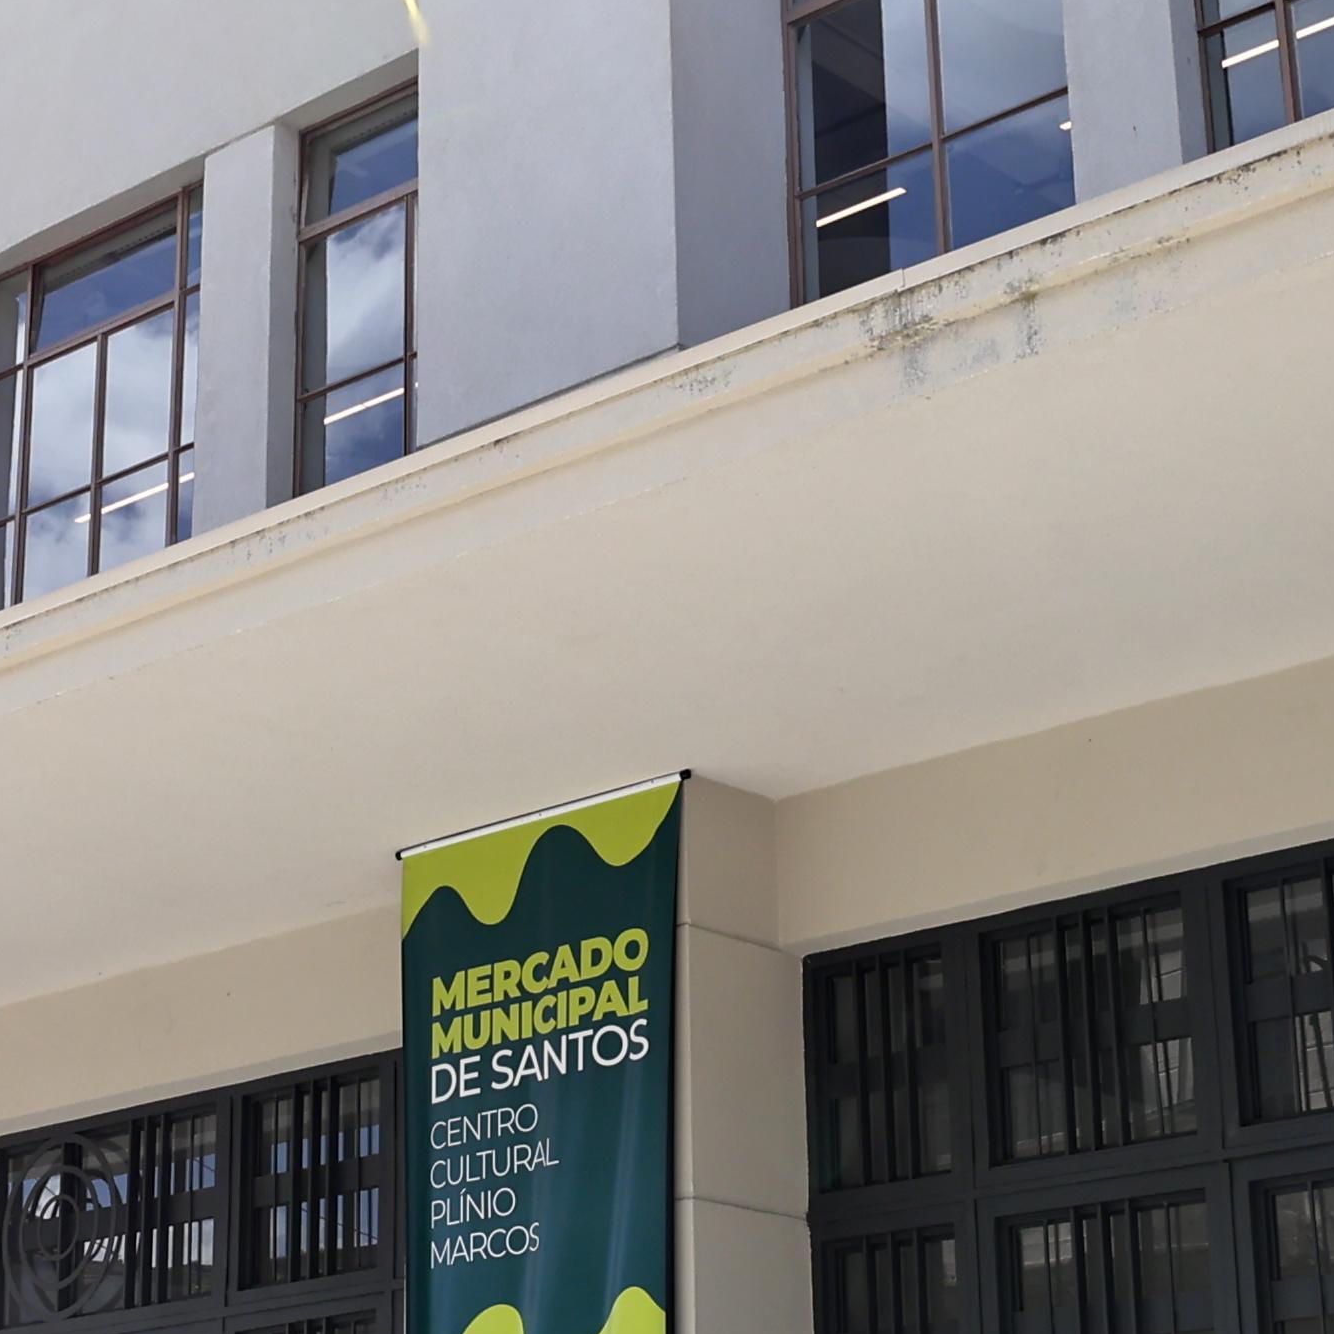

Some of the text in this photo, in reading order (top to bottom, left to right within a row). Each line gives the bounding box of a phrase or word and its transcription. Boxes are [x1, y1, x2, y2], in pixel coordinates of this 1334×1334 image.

[432, 928, 649, 1016] MERCADO
[432, 976, 649, 1059] MUNICIPAL
[431, 1018, 649, 1104] DE SANTOS
[430, 1103, 538, 1149] CENTRO
[430, 1139, 559, 1189] CULTURAL
[431, 1187, 516, 1229] PLÍNIO
[431, 1223, 540, 1268] MARCOS
